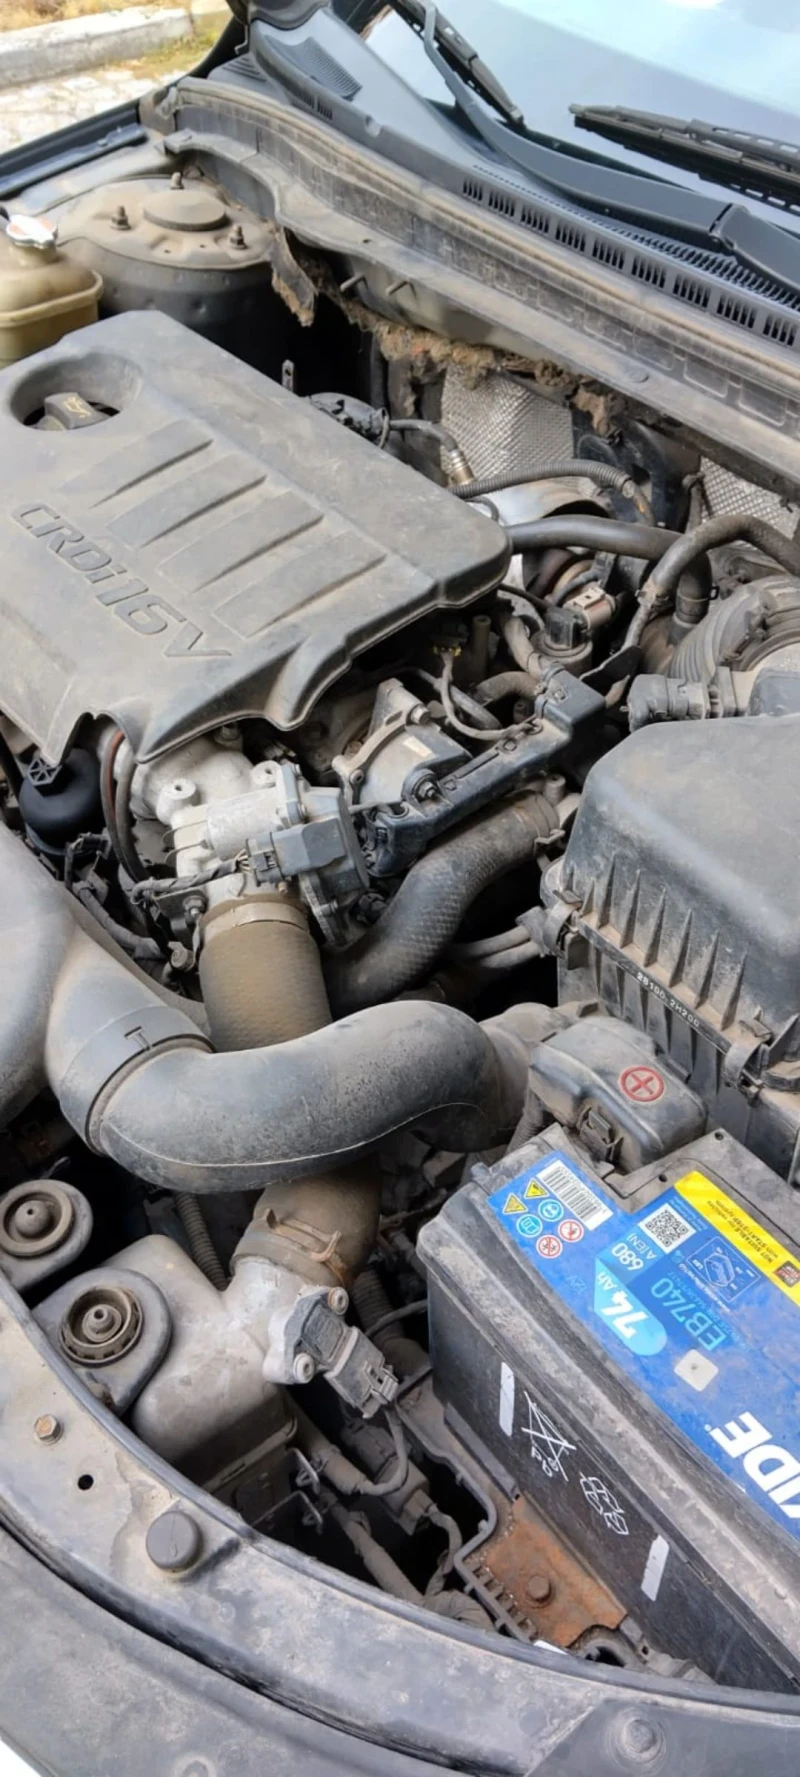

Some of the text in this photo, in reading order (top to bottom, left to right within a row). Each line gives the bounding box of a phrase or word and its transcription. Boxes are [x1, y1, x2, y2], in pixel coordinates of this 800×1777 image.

[644, 1250, 657, 1262] A
[735, 1226, 762, 1252] SUITABLE
[610, 1241, 646, 1275] 680
[760, 1250, 773, 1263] NOT
[596, 1270, 649, 1338] 74 Ah
[649, 1275, 728, 1351] EB740
[708, 1411, 800, 1517] IDE
